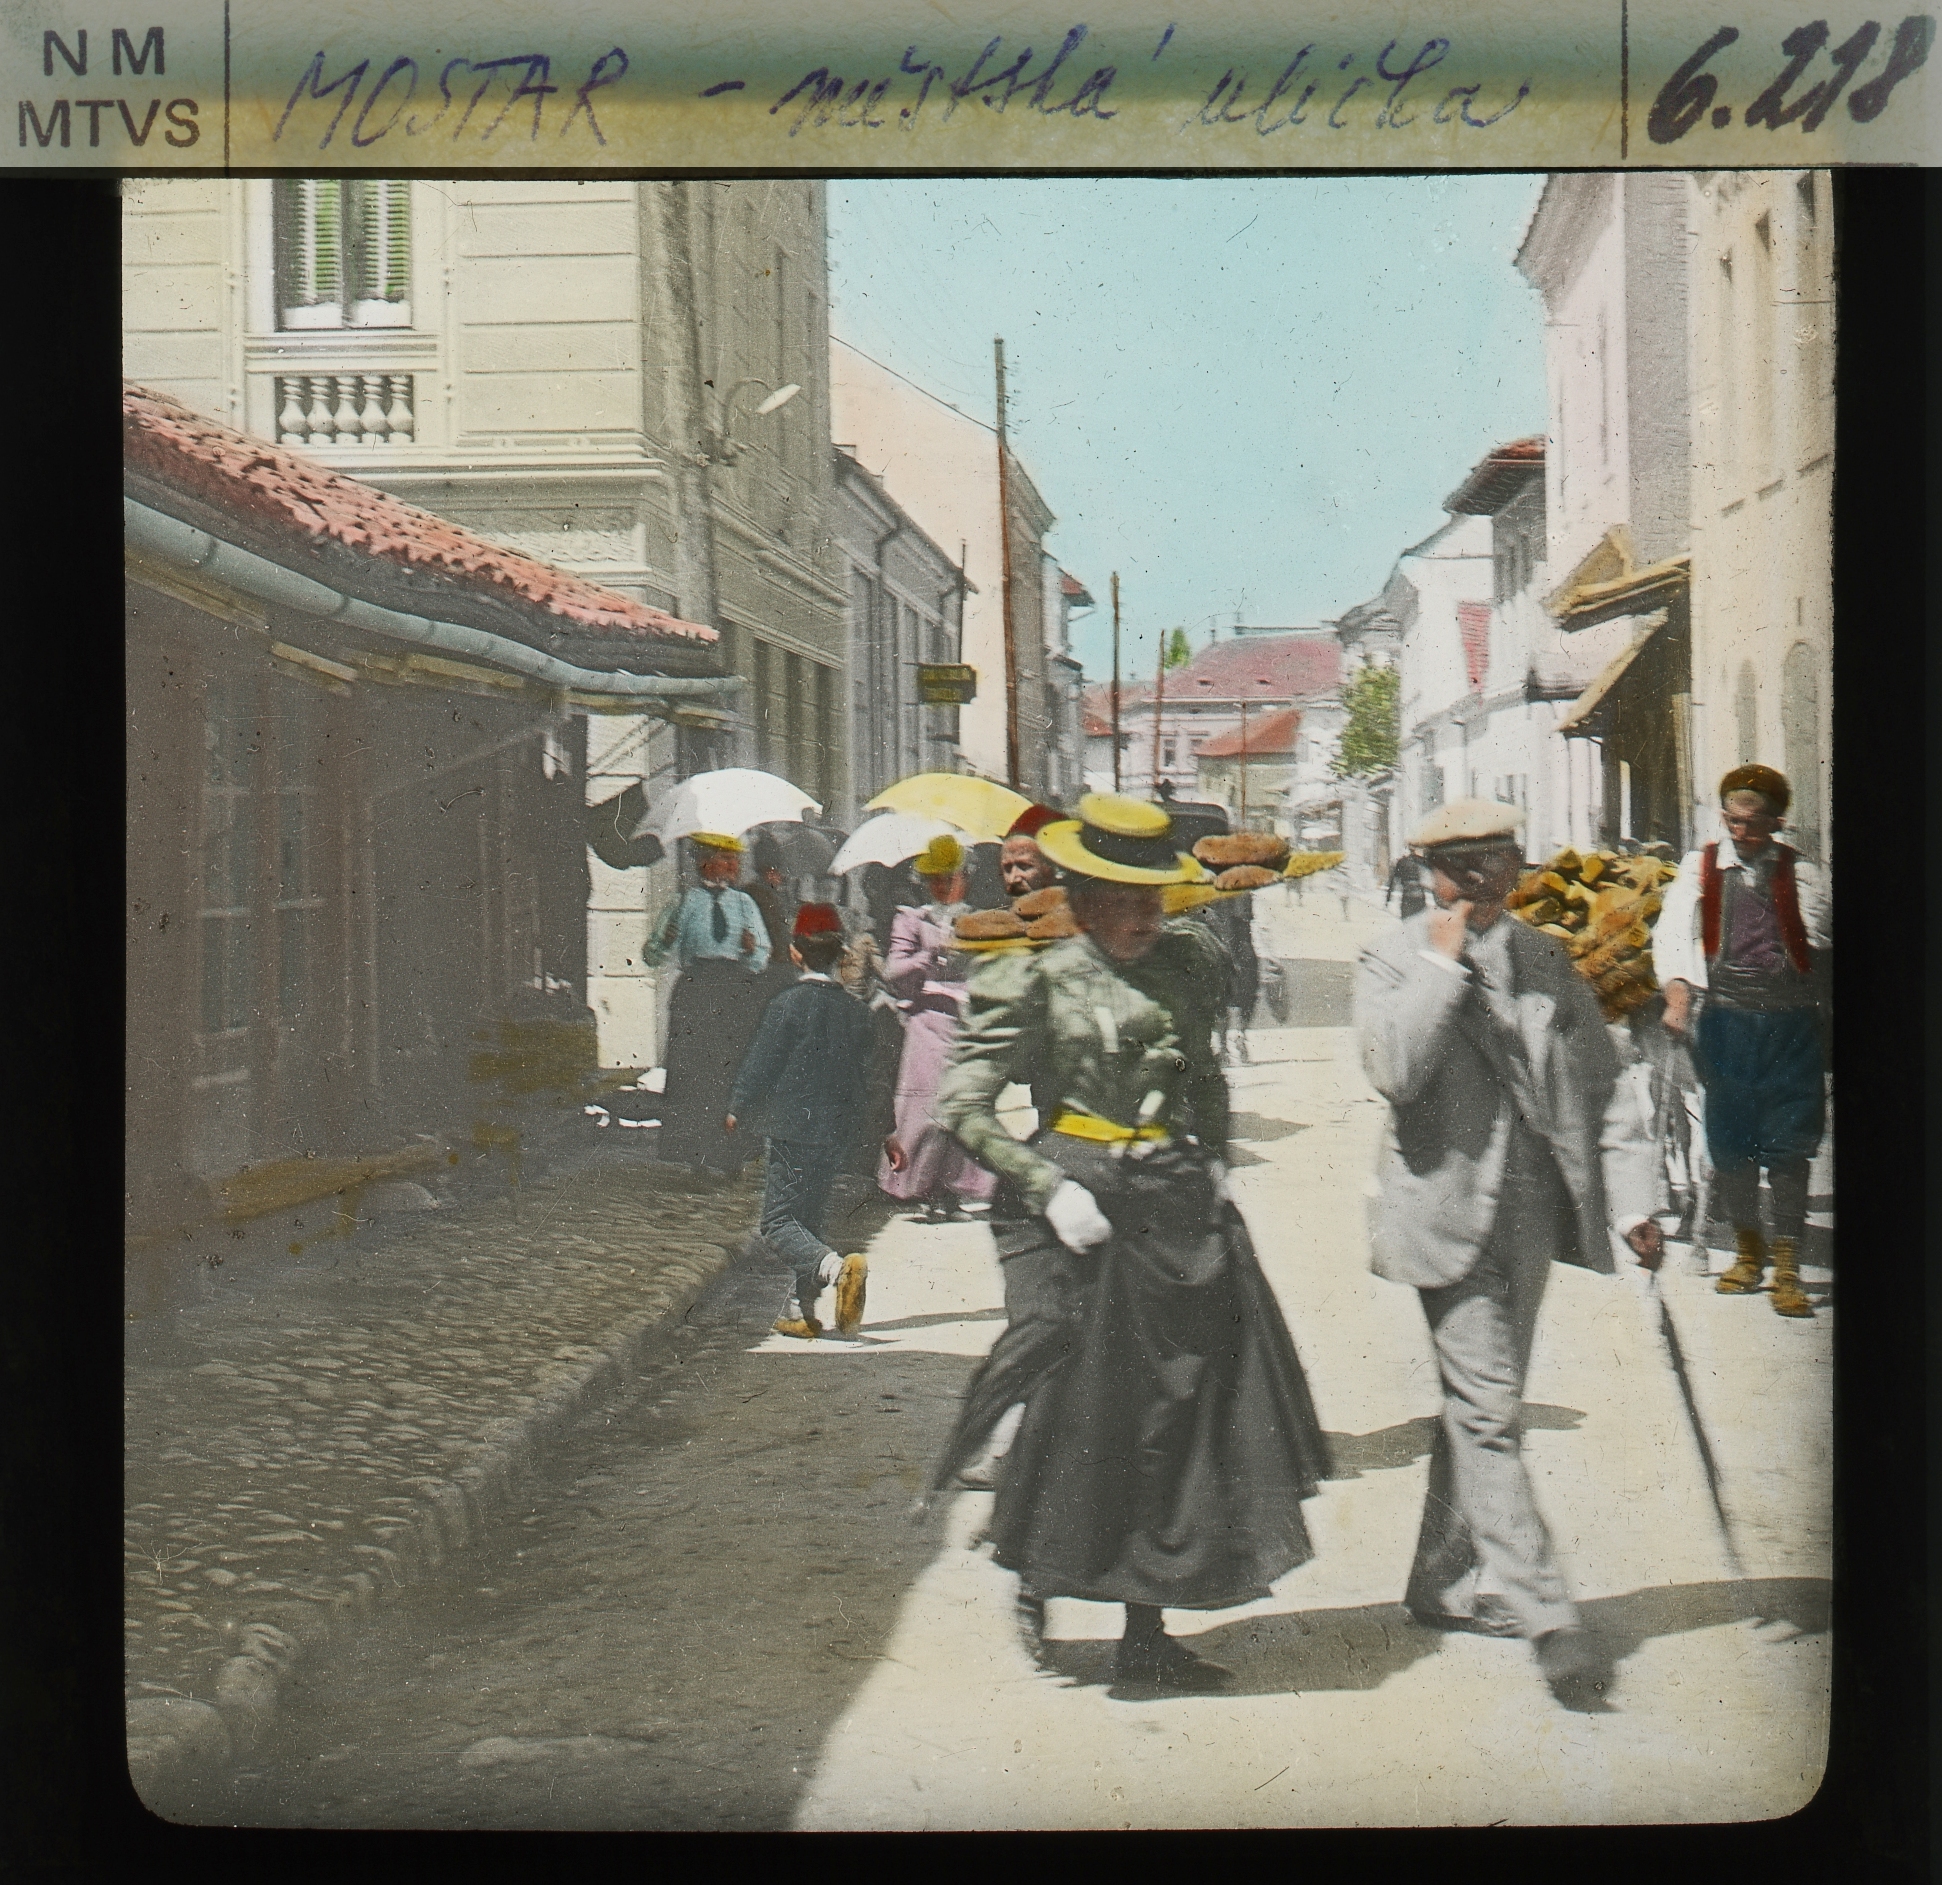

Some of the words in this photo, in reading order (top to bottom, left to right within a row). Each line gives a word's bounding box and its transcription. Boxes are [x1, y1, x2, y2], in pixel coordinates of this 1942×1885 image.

[18, 98, 200, 148] MTVS
[272, 47, 630, 149] MOSTAR
[1647, 14, 1937, 145] 6.218
